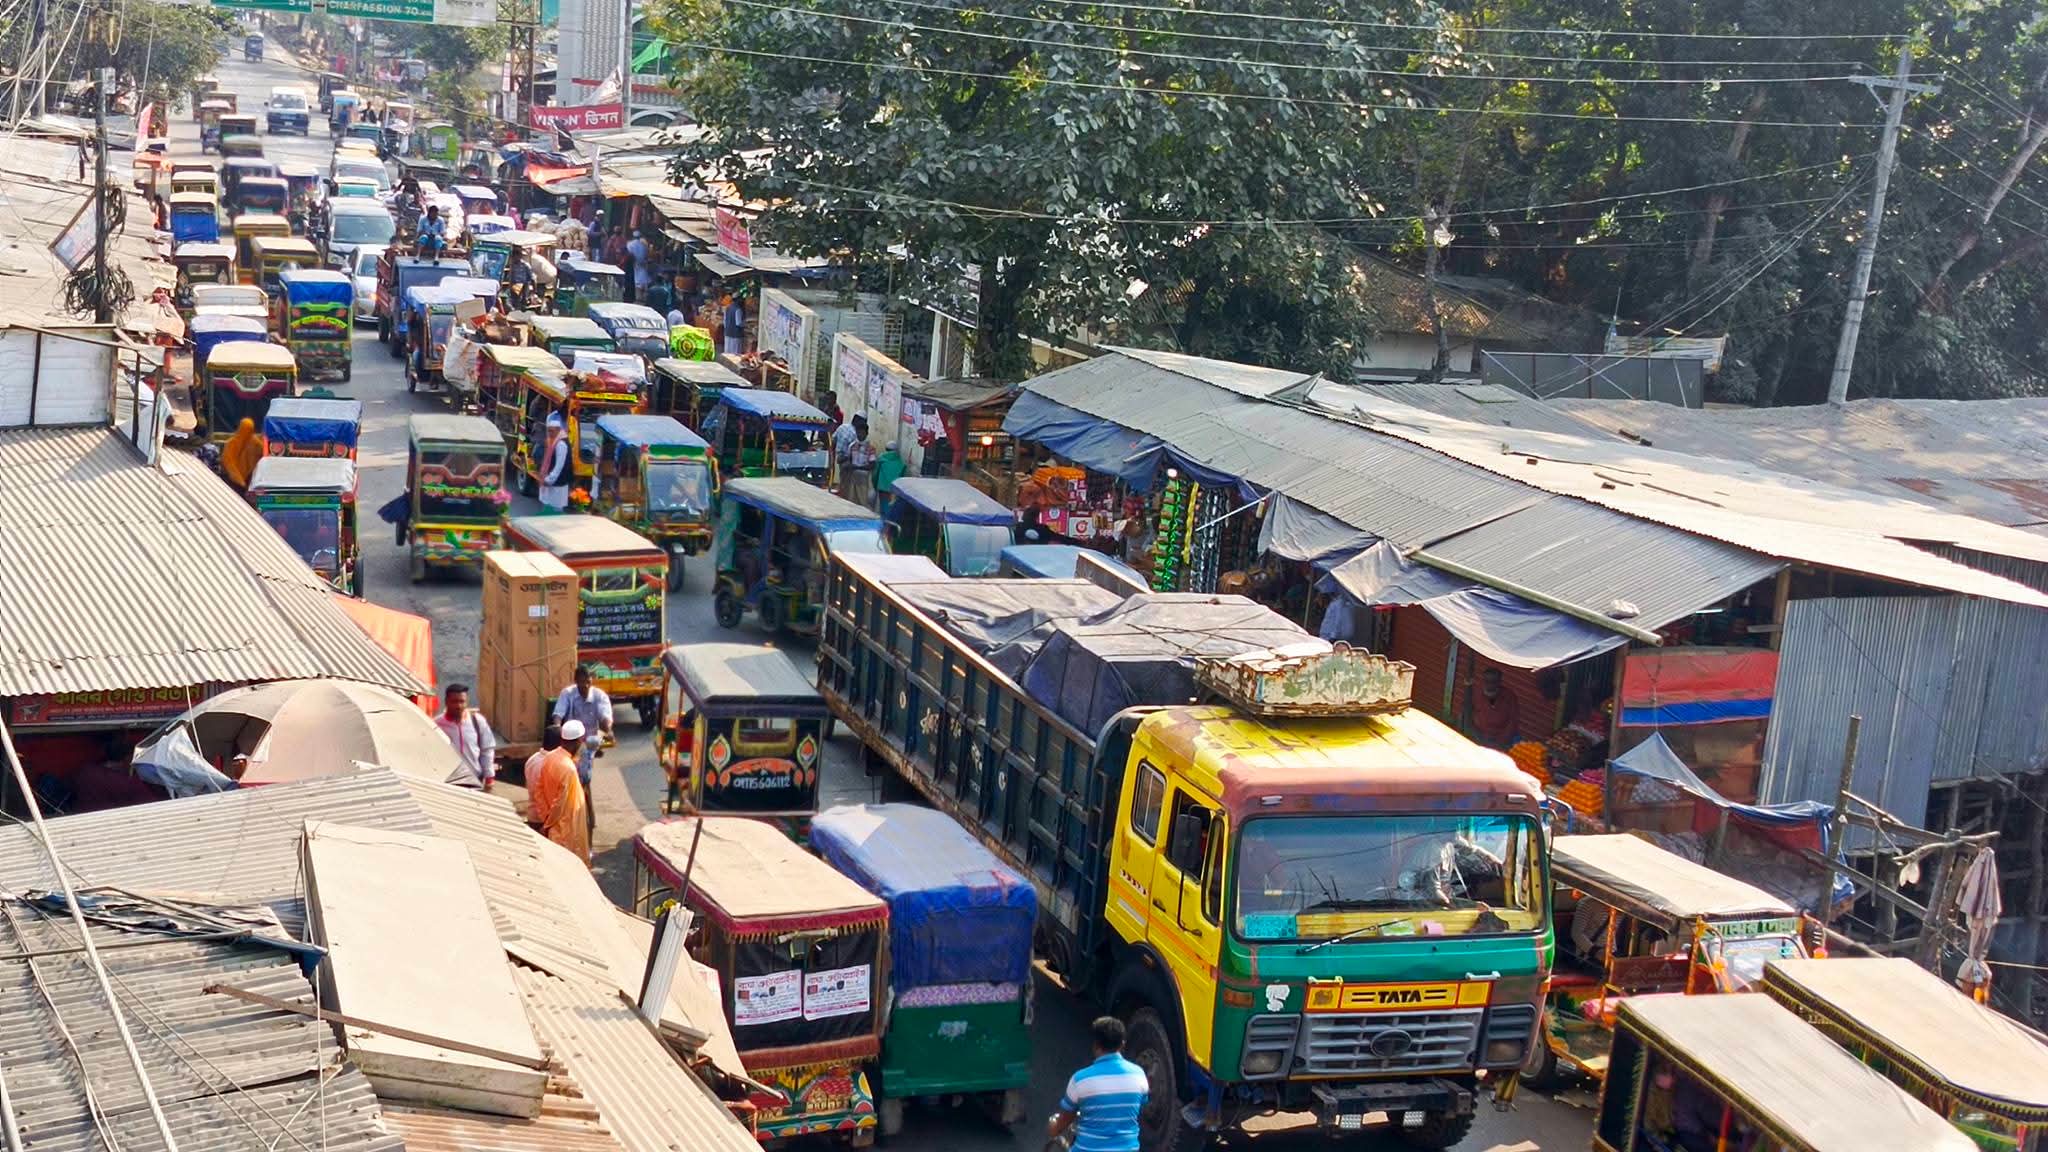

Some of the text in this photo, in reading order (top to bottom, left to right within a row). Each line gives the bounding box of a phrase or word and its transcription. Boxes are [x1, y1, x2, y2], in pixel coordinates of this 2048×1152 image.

[327, 1, 400, 14] CHARFASSION
[585, 110, 619, 125] ভিশন
[1378, 990, 1422, 1004] TATA
